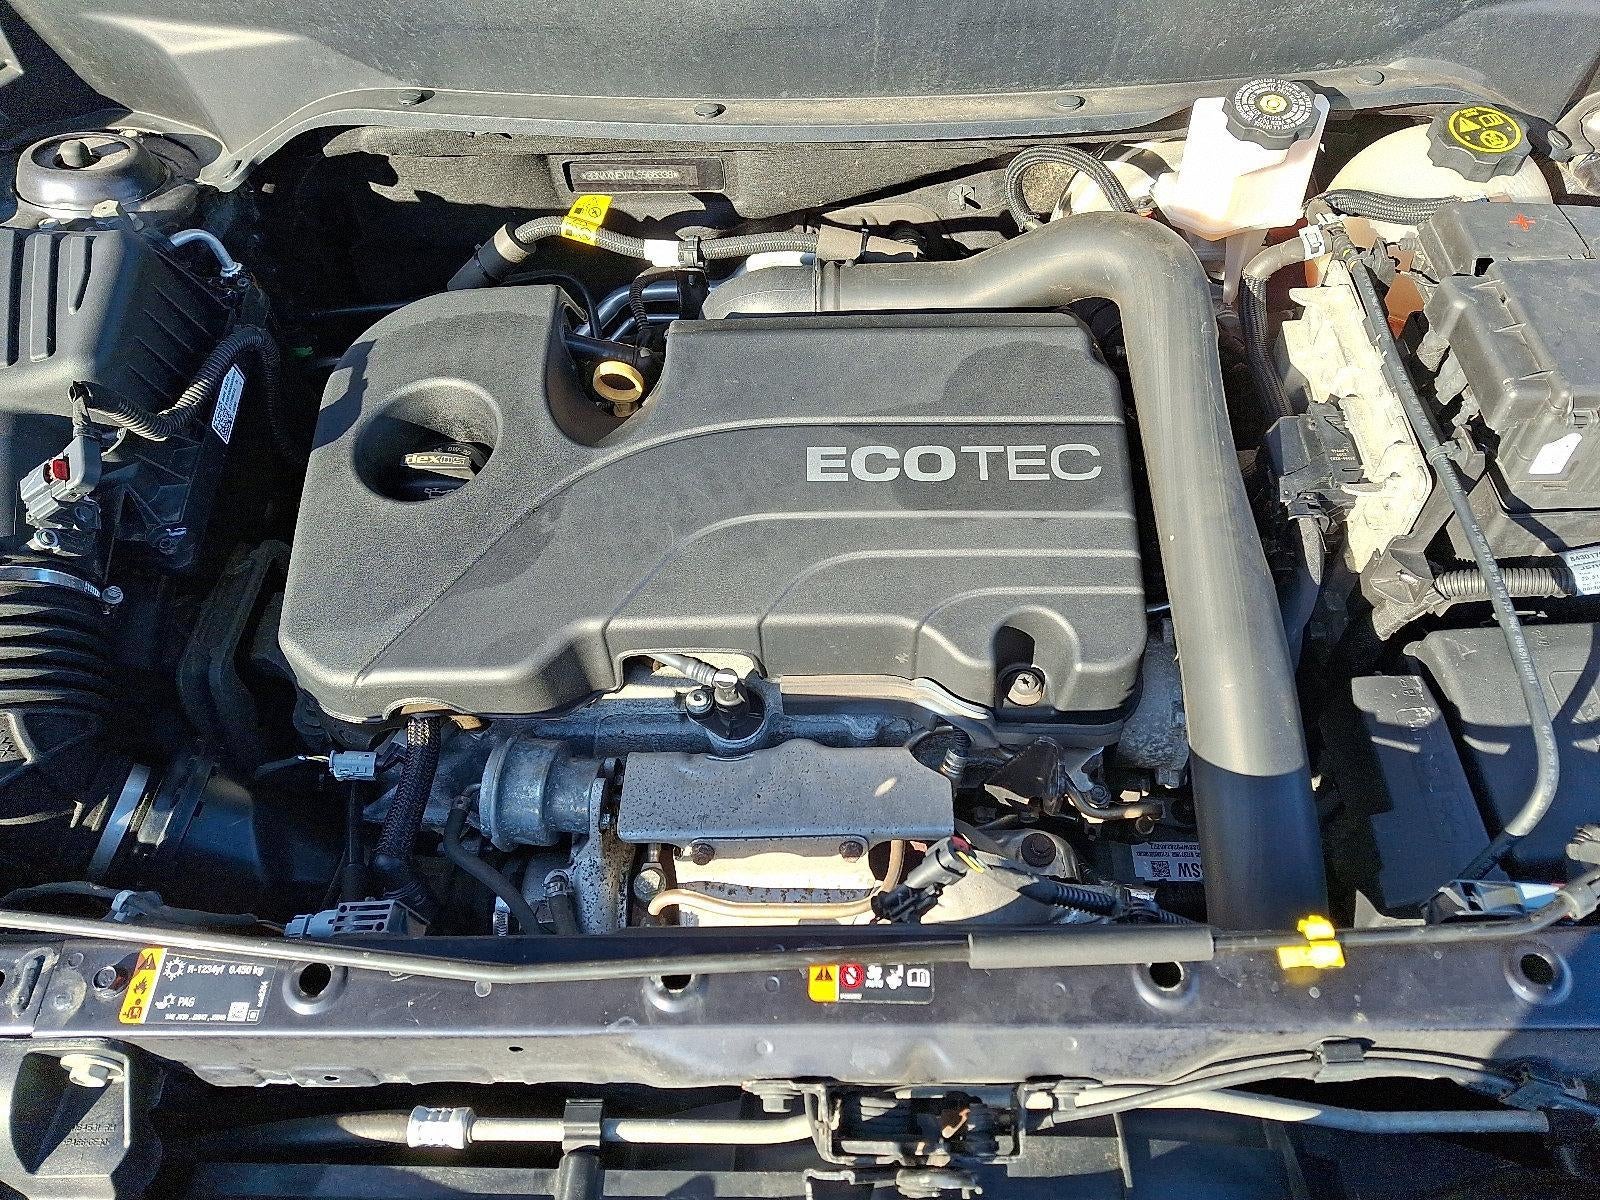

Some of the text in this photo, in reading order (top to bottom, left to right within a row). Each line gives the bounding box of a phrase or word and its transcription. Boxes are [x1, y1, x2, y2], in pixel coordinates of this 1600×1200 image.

[405, 454, 467, 465] dexos
[806, 443, 1102, 482] ECOTEC
[1178, 861, 1204, 878] SW
